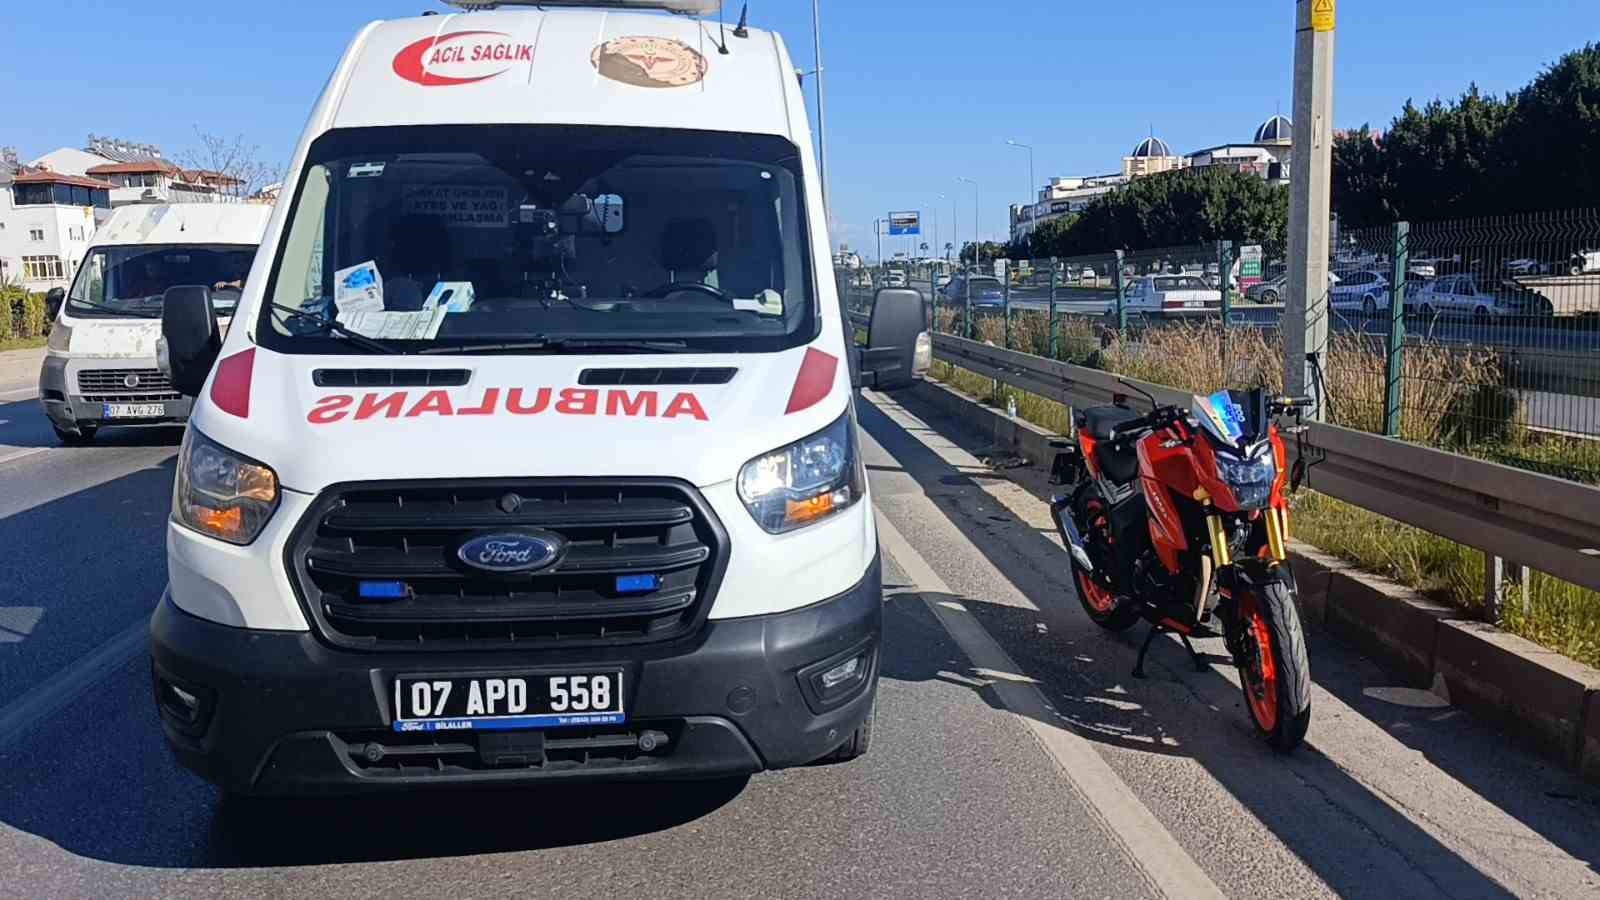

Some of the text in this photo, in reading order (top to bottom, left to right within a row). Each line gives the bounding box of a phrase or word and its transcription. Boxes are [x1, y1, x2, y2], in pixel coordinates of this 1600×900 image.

[479, 541, 531, 562] Ford
[411, 676, 611, 717] 07 APD 558
